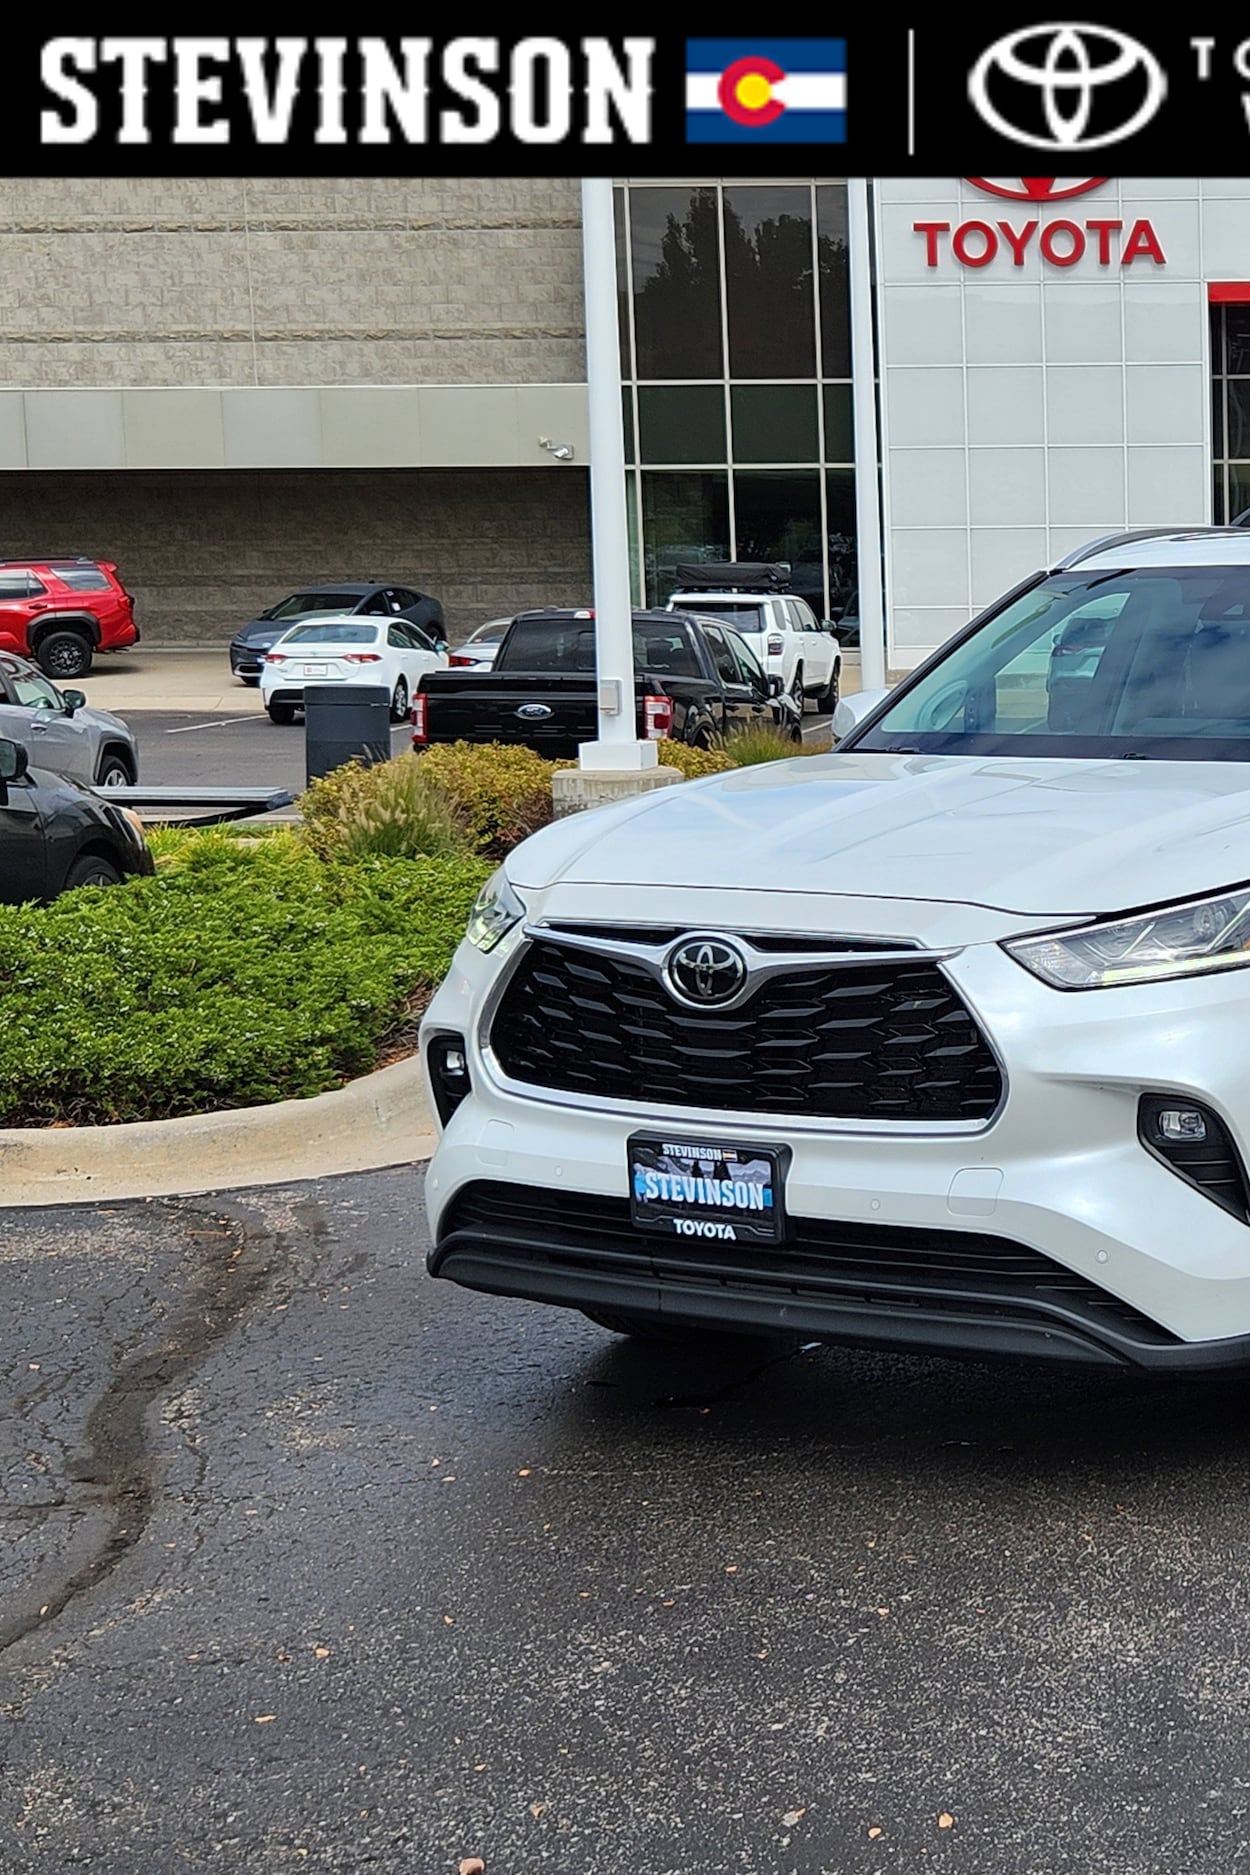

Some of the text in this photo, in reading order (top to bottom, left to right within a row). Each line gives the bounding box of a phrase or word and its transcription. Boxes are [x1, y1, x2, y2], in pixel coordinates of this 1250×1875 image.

[913, 219, 1166, 268] TOYOTA
[661, 1143, 723, 1162] STEVINSON
[644, 1171, 764, 1211] STEVINSON
[673, 1218, 737, 1241] TOYOTA
